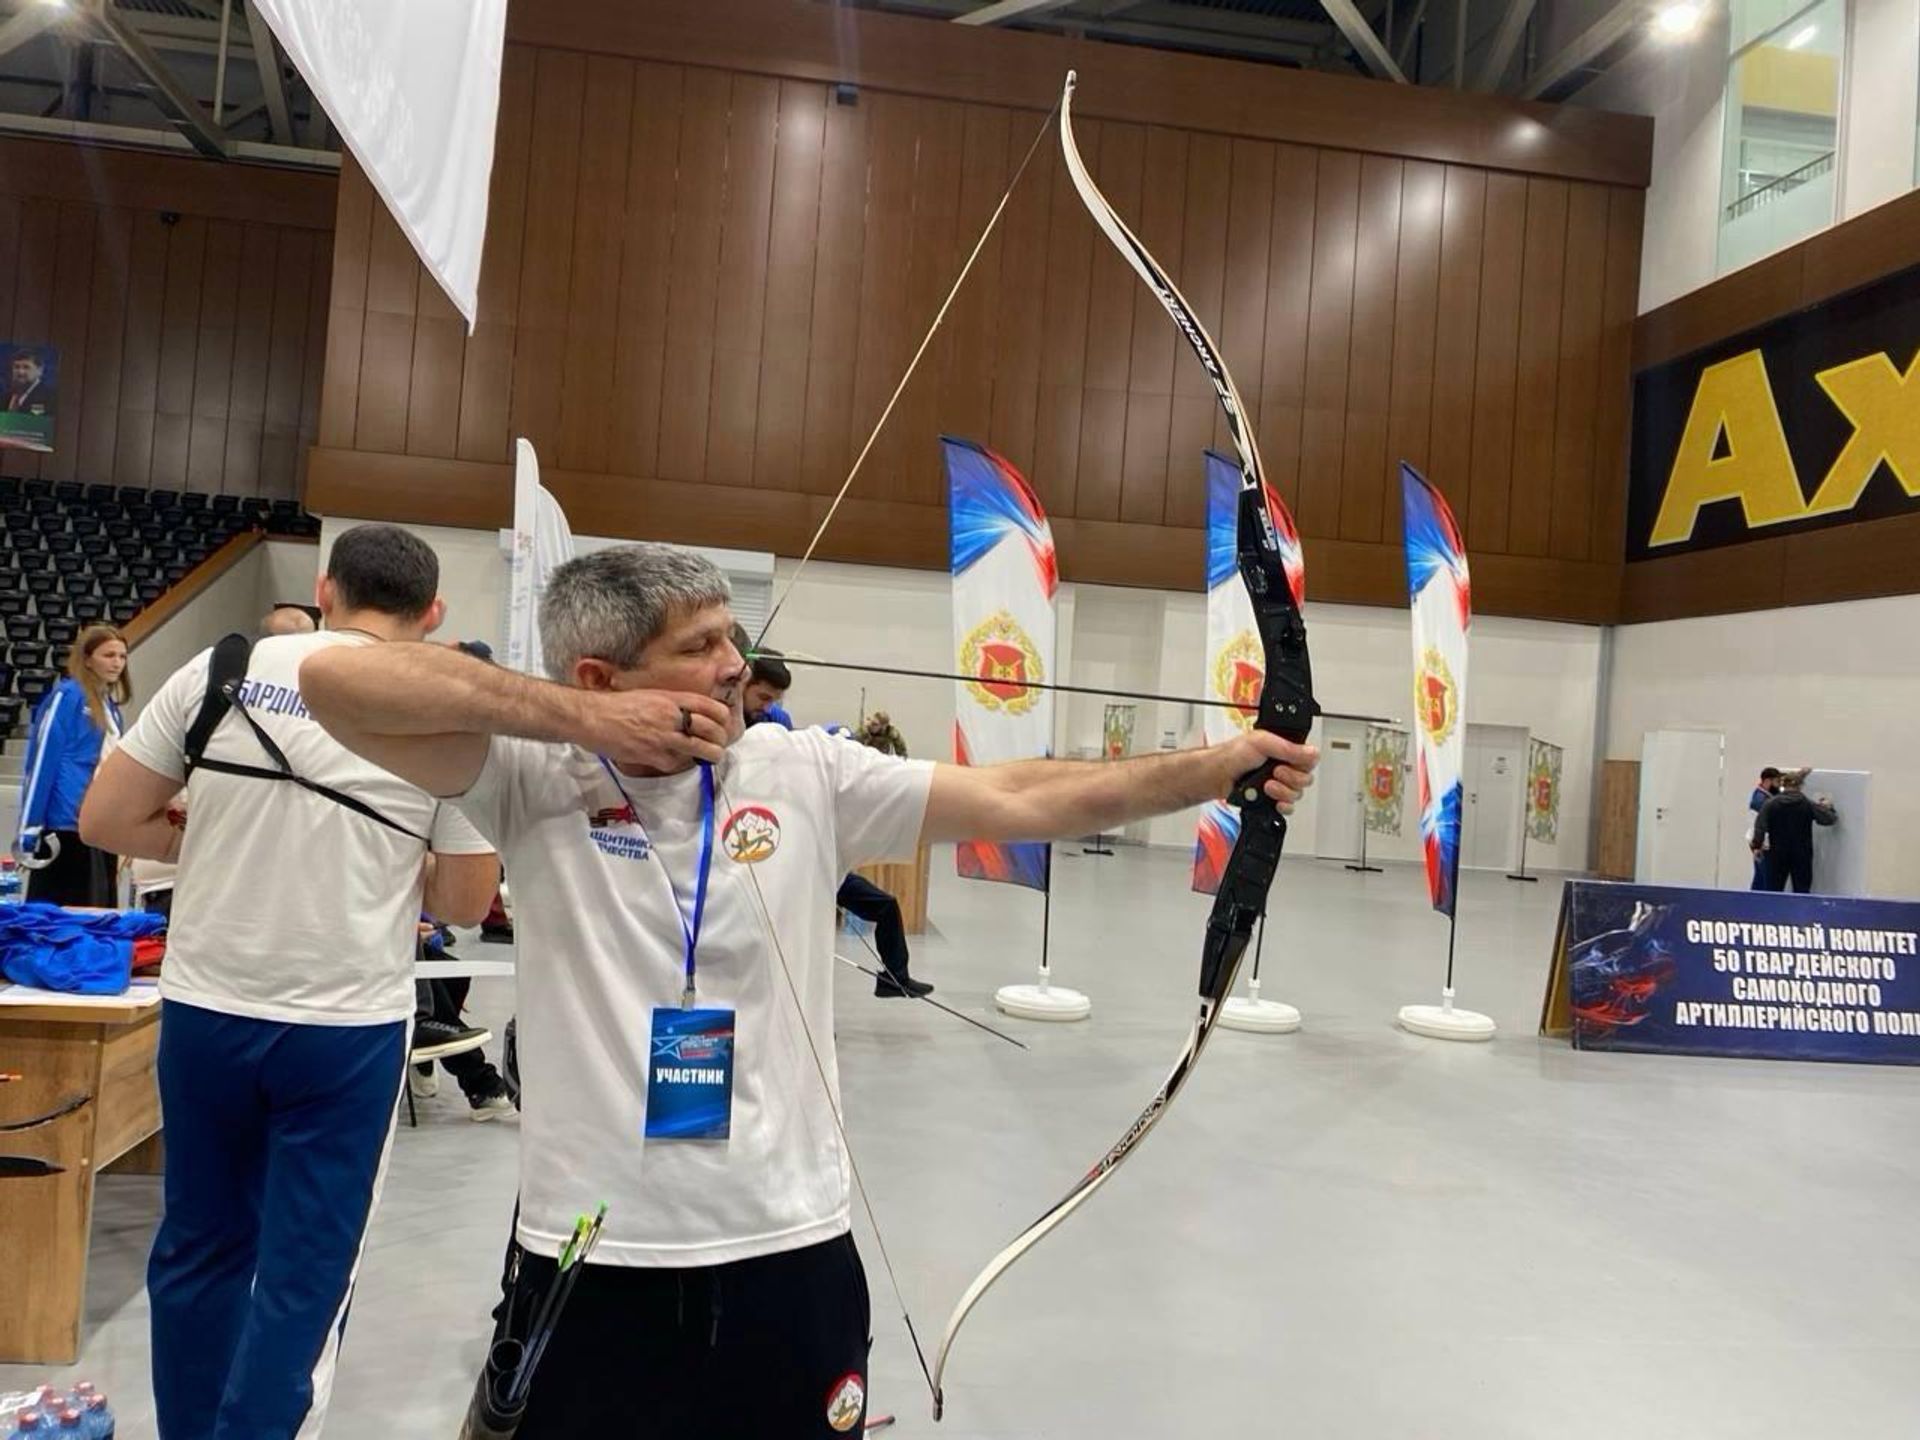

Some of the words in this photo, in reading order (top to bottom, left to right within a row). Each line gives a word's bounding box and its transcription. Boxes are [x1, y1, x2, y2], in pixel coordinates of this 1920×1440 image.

[1686, 919, 1825, 949] СПОРТИВНЫЙ
[1829, 928, 1918, 955] КОМИТЕТ
[1713, 949, 1740, 973] 50
[1745, 950, 1896, 980] ГВАРДЕЙСКОГО
[1732, 977, 1881, 1007] САМОХОДНОГО
[1676, 1002, 1870, 1034] АРТИЛЛЕРИЙСКОГО
[656, 1067, 724, 1085] УЧАСТНИК
